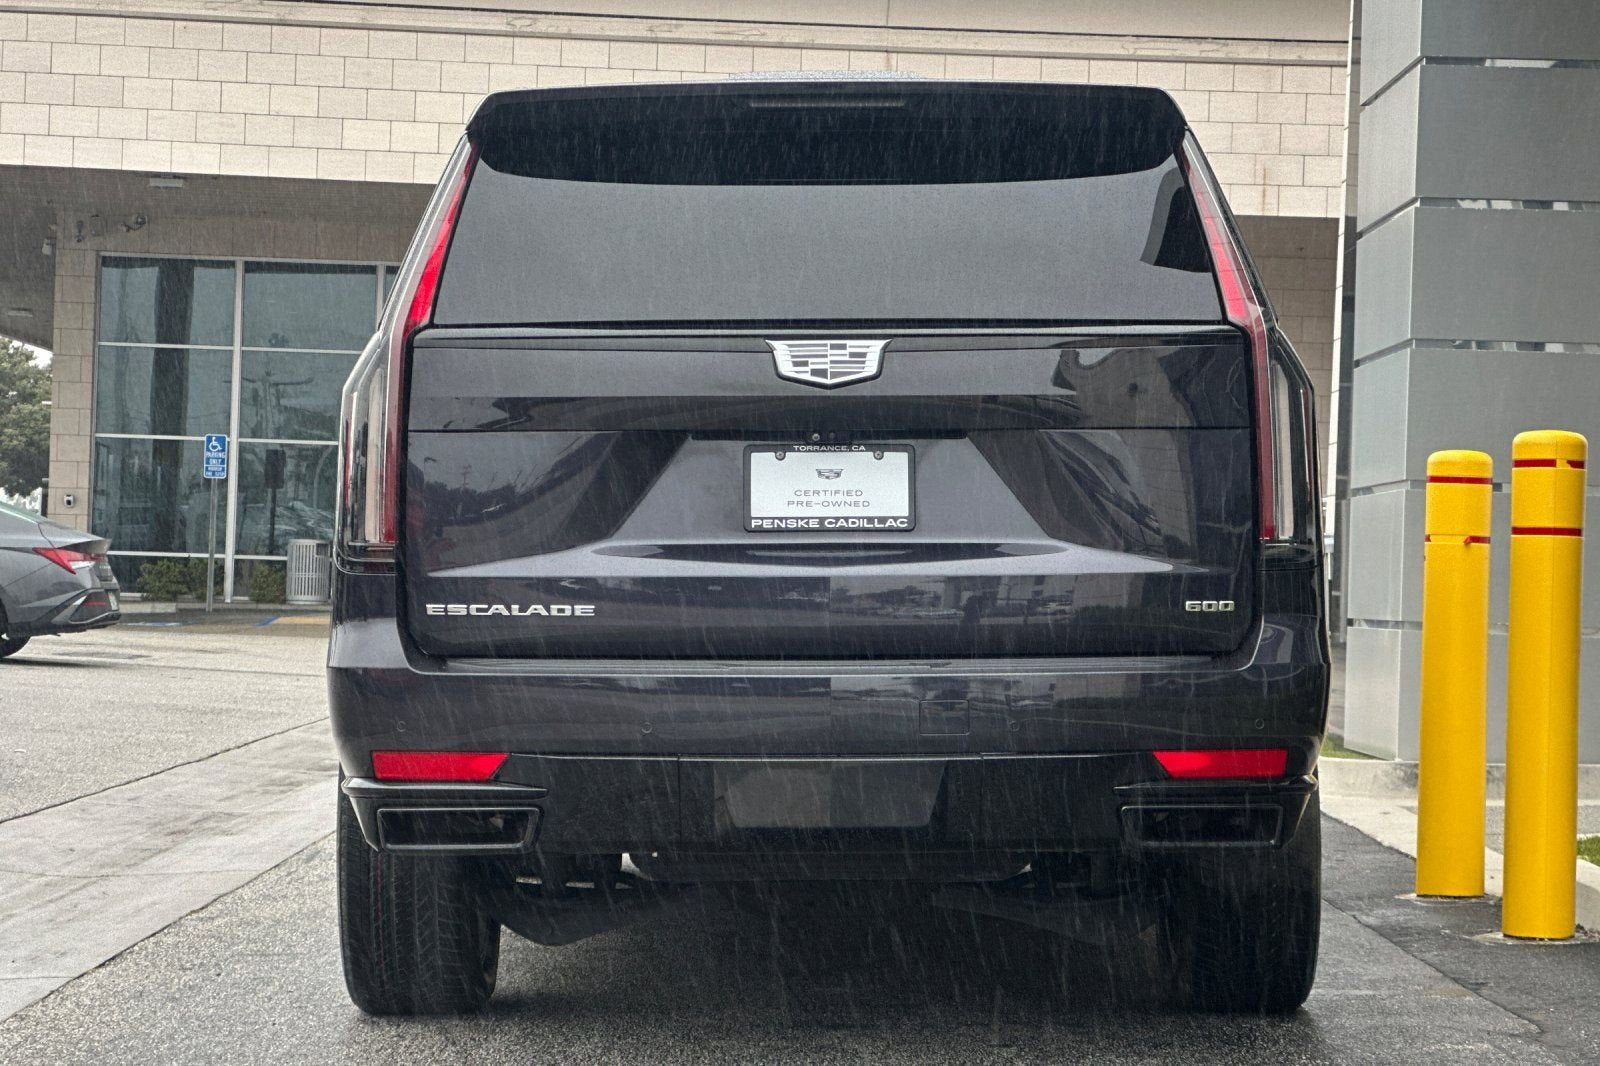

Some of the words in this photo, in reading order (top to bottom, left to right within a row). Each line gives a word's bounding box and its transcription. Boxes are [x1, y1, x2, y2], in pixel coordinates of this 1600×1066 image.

[794, 489, 863, 497] CERTIFIED
[787, 500, 870, 508] PRE-OWNED
[751, 518, 820, 528] PENSKE
[824, 518, 908, 528] CADILLAC
[425, 604, 596, 616] ESCALADE
[1185, 600, 1235, 612] 600
